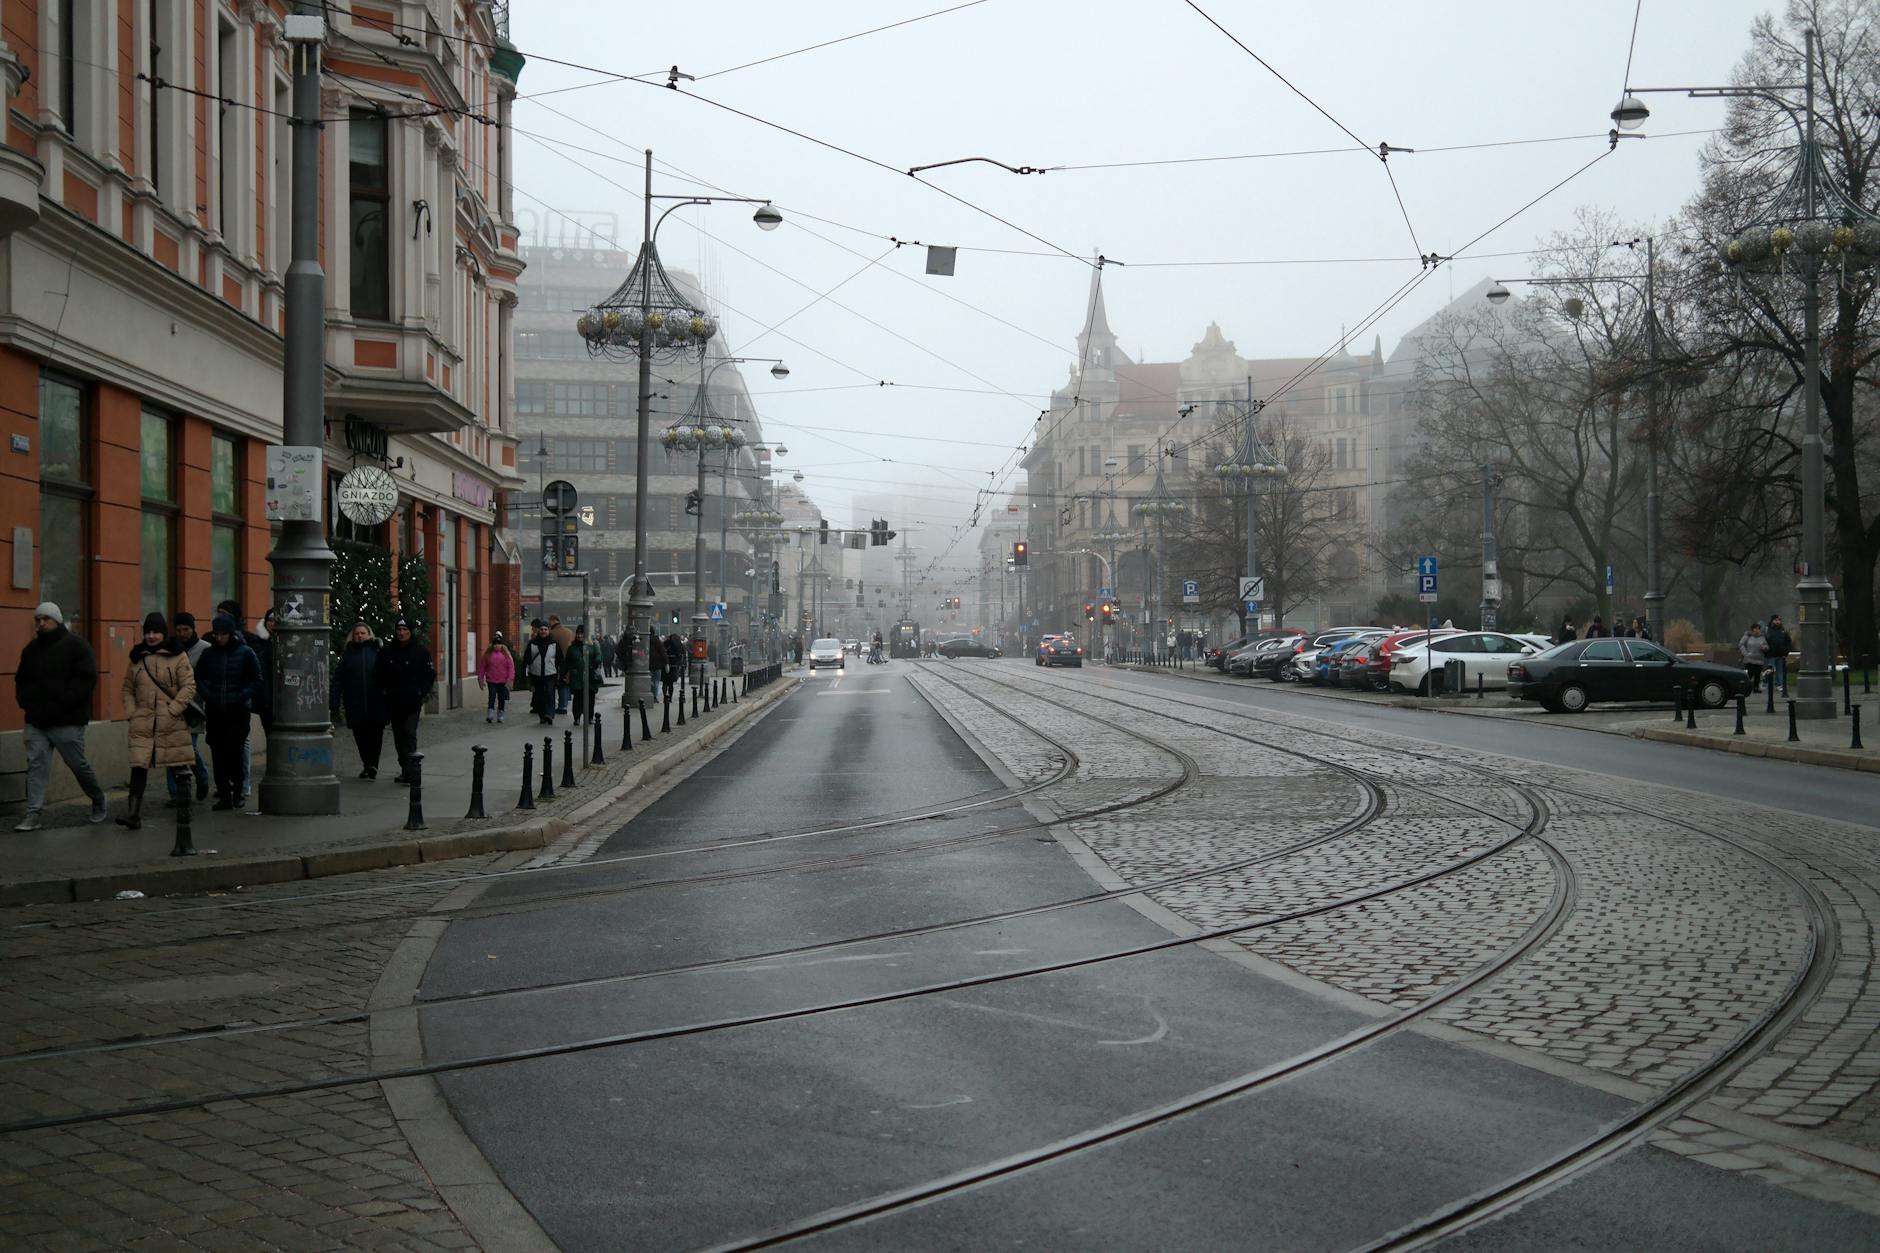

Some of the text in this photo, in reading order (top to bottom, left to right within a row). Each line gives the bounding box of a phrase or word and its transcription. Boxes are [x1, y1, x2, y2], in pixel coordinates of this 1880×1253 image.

[342, 490, 394, 501] GNIAZDO
[1186, 583, 1196, 595] P
[1423, 576, 1434, 591] P
